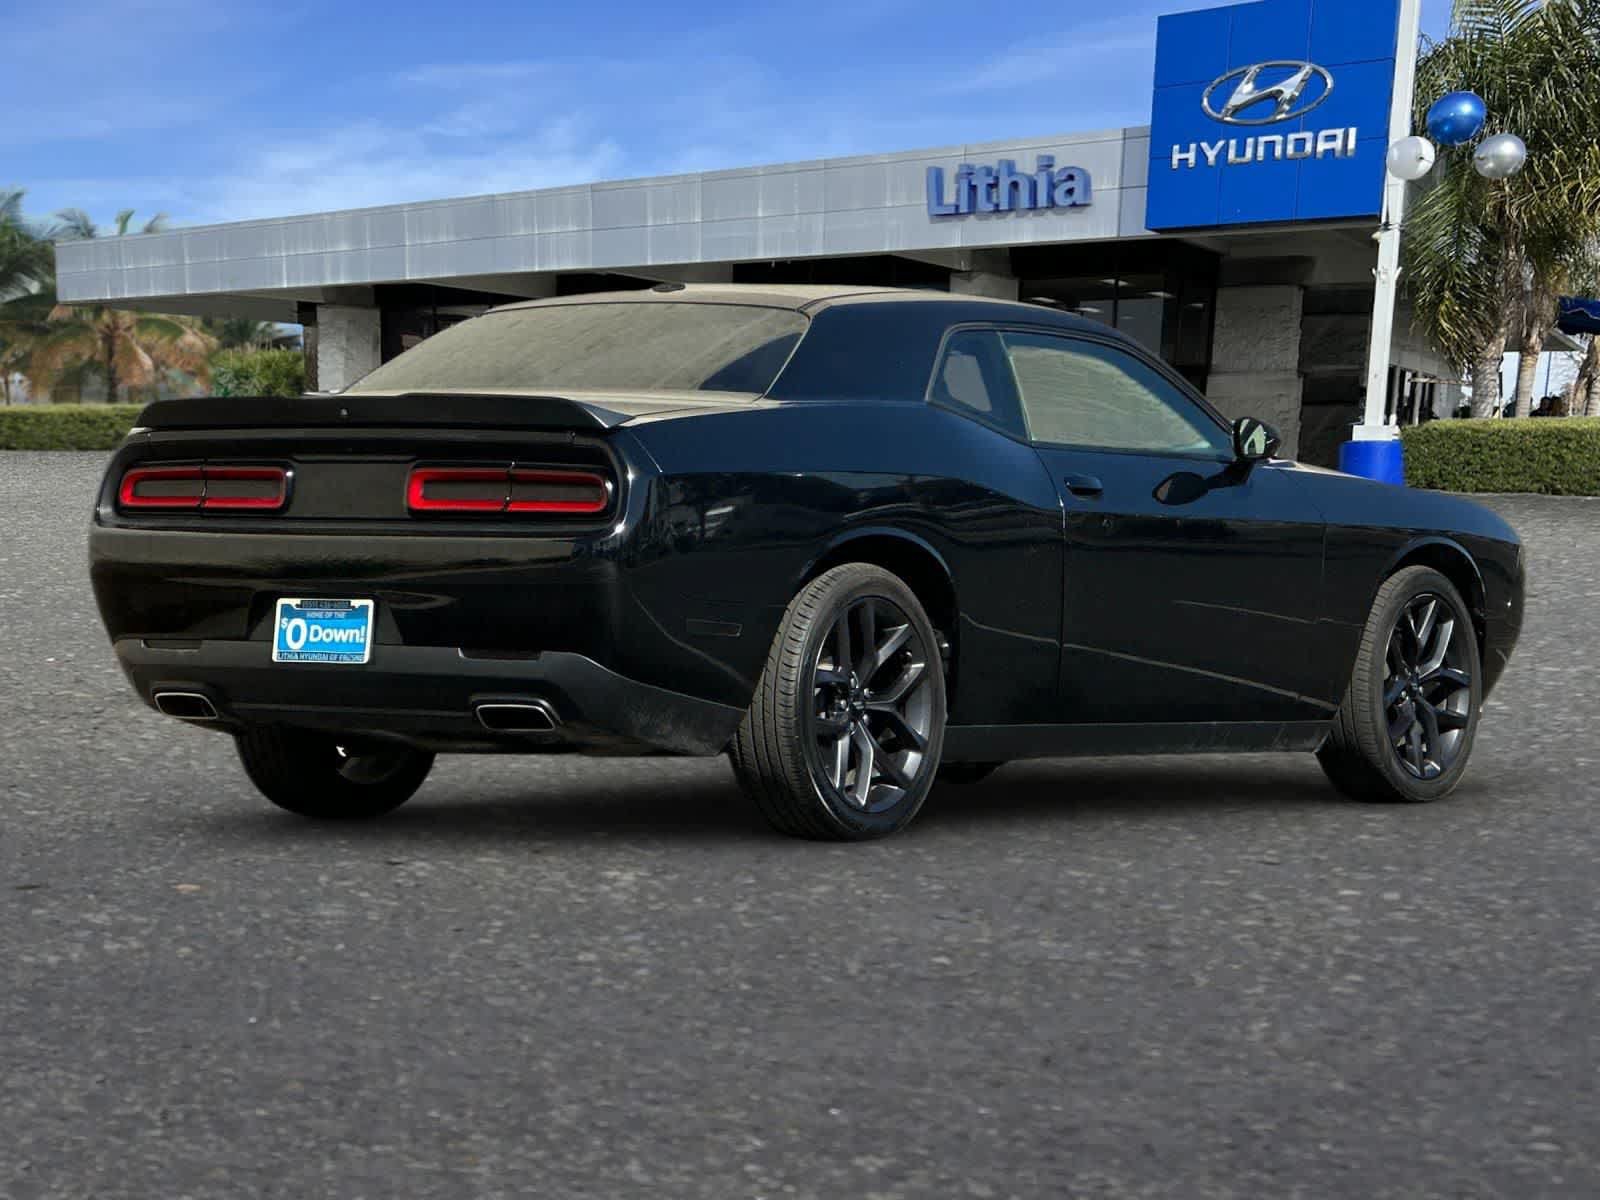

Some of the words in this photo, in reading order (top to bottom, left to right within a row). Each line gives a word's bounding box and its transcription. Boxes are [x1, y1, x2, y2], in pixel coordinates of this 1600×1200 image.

[1171, 127, 1358, 169] HYUNDAI
[926, 155, 1093, 216] Lithia
[309, 624, 366, 643] Down!
